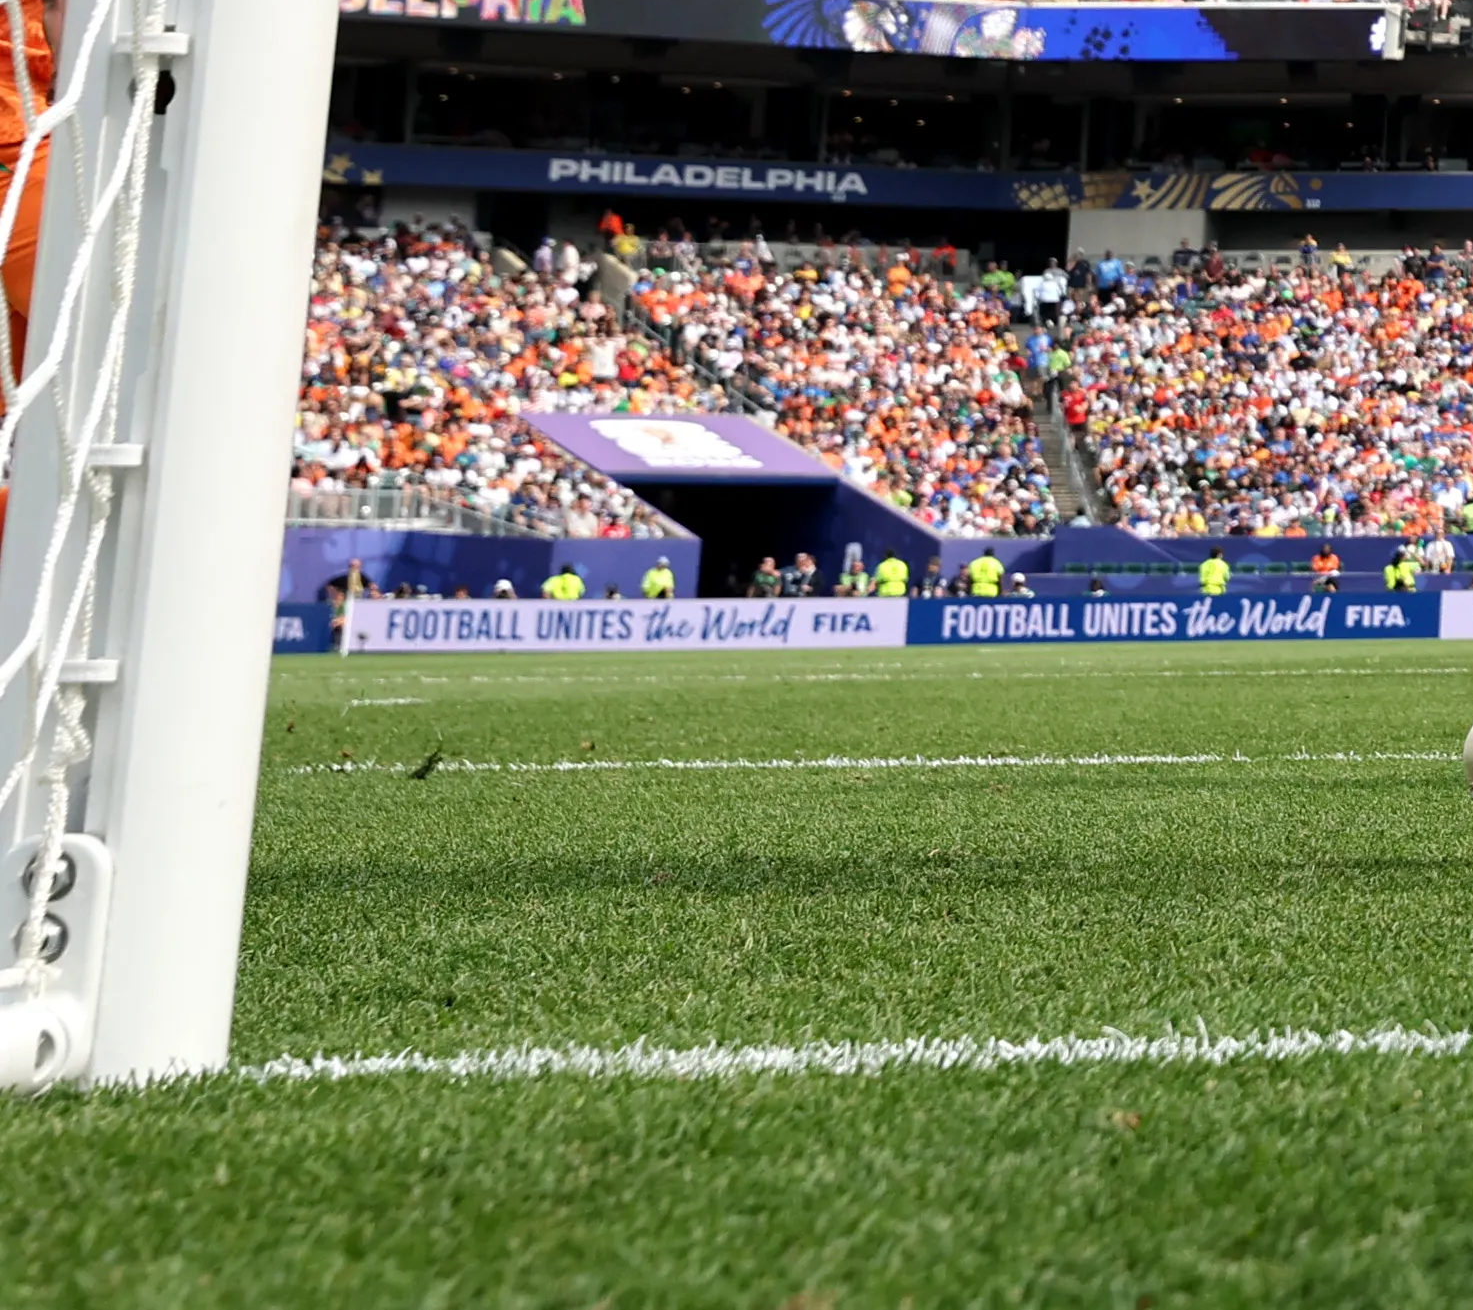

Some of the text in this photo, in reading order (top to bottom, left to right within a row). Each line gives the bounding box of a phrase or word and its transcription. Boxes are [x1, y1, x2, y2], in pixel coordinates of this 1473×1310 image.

[548, 158, 868, 195] PHILADELPHIA
[387, 601, 875, 643] FOOTBALL UNITES the World FIFA
[940, 594, 1407, 639] FOOTBALL UNITES the World FIFA
